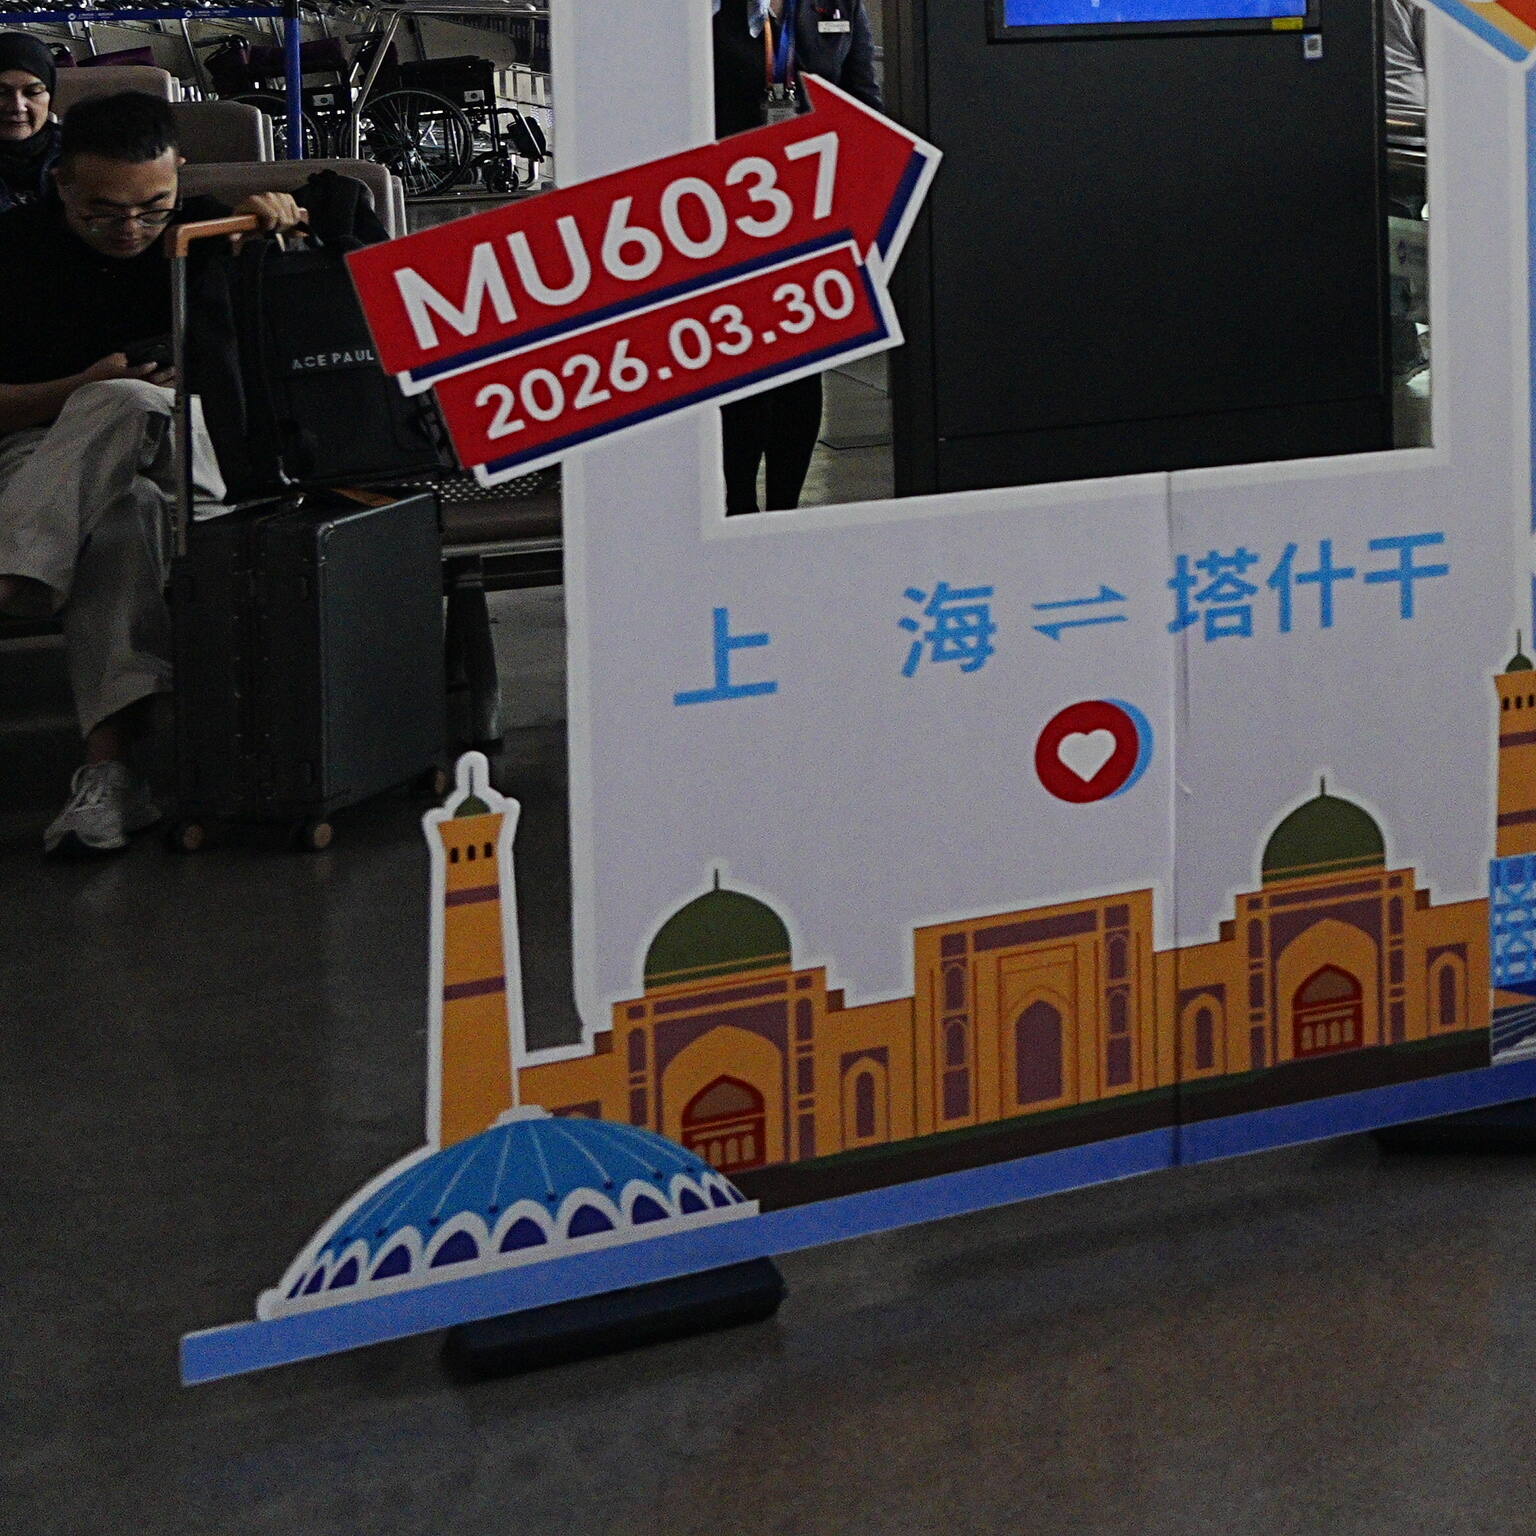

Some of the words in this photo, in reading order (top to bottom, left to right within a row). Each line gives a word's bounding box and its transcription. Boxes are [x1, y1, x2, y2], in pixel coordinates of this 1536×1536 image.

[394, 130, 839, 350] MU6037
[292, 354, 327, 370] ACE
[331, 349, 375, 364] PAUL
[474, 268, 856, 441] 2026.03.30
[1166, 531, 1451, 644] 塔什干
